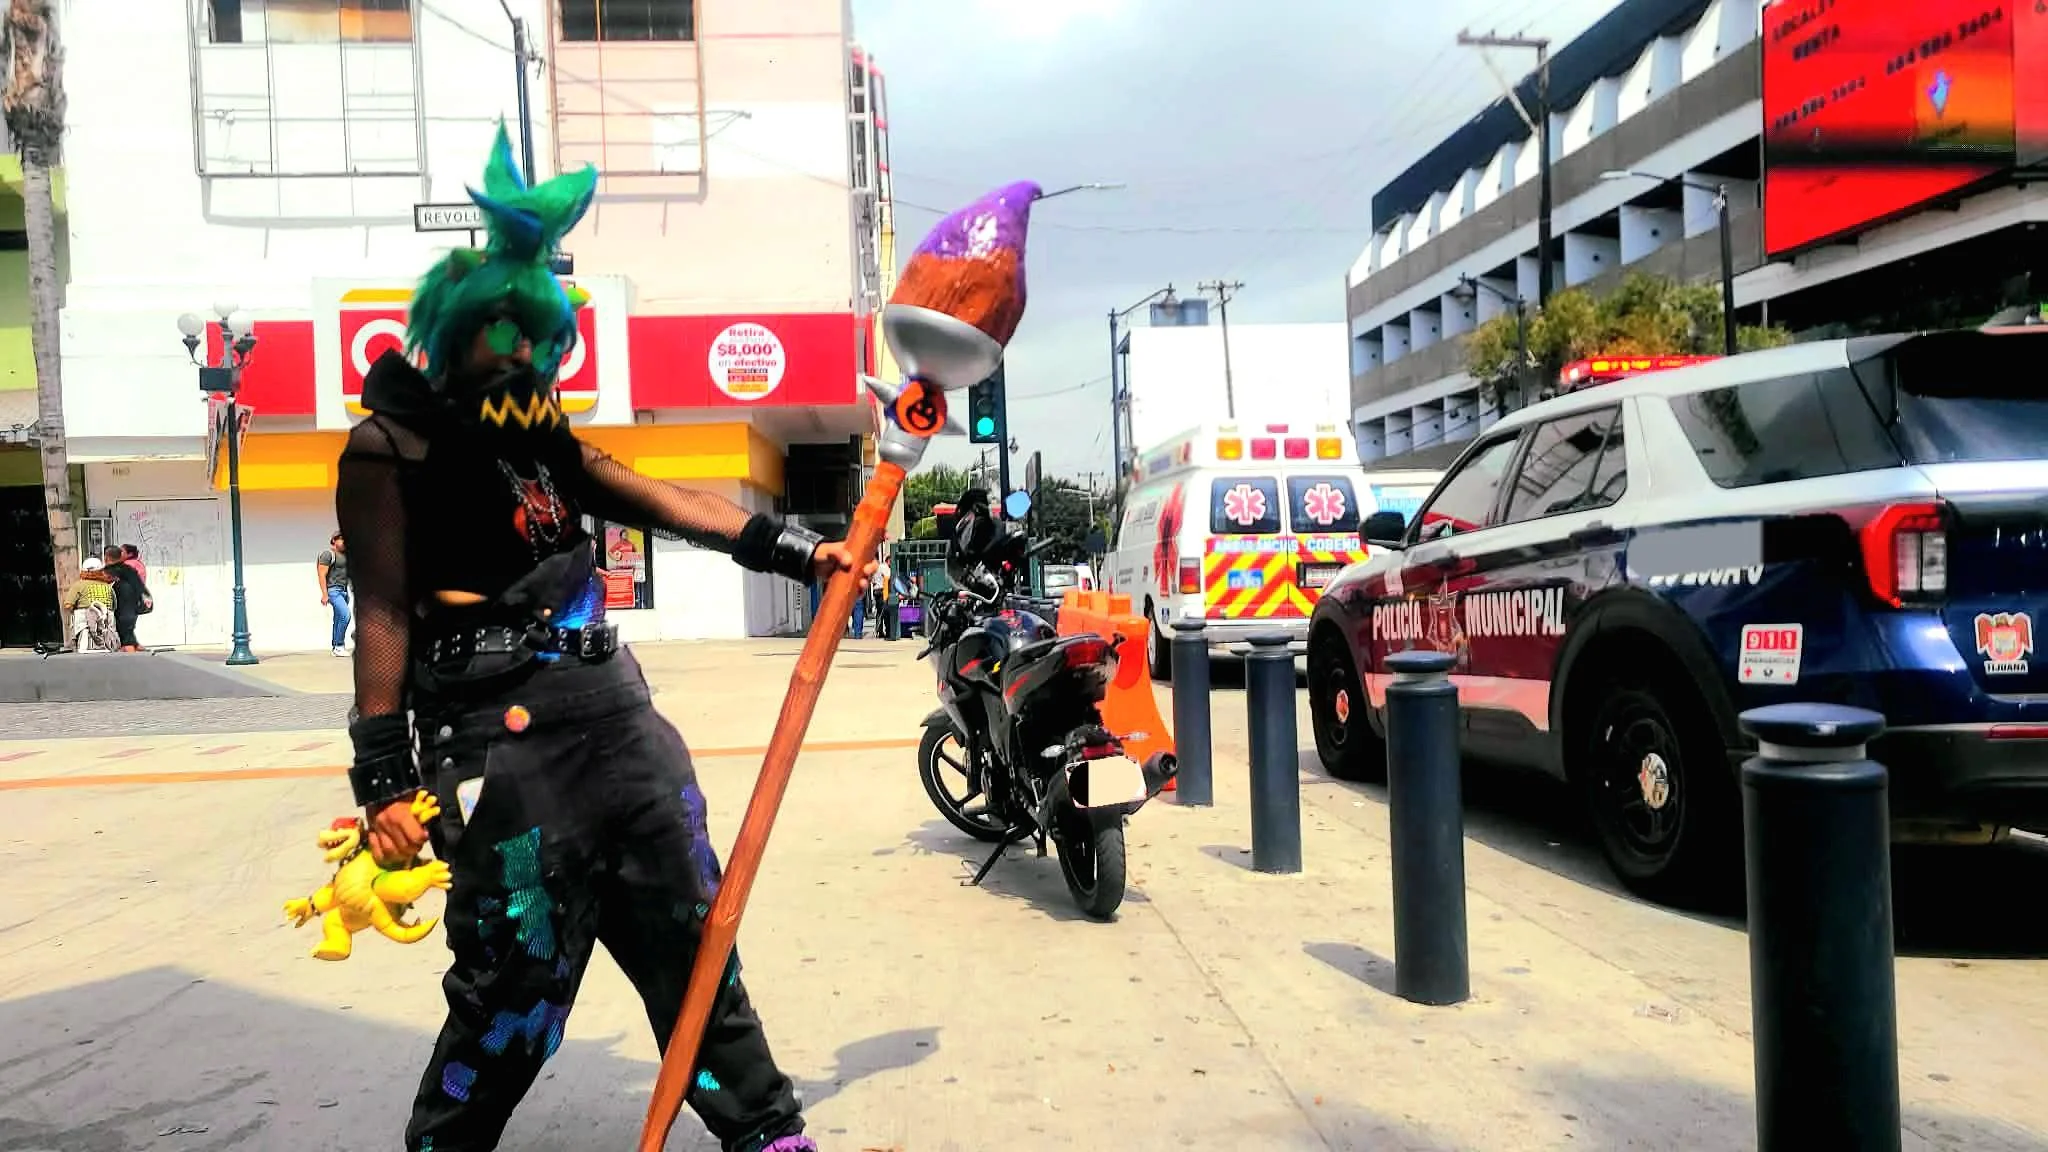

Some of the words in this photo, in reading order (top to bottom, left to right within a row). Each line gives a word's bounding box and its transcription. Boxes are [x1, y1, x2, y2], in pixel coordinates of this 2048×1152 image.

[729, 327, 765, 337] Retira
[734, 357, 777, 367] efectivo
[1373, 596, 1424, 641] POLICÍA
[1465, 587, 1567, 638] MUNICIPAL
[1748, 631, 1795, 649] 911
[1987, 663, 2026, 672] TIJUANA
